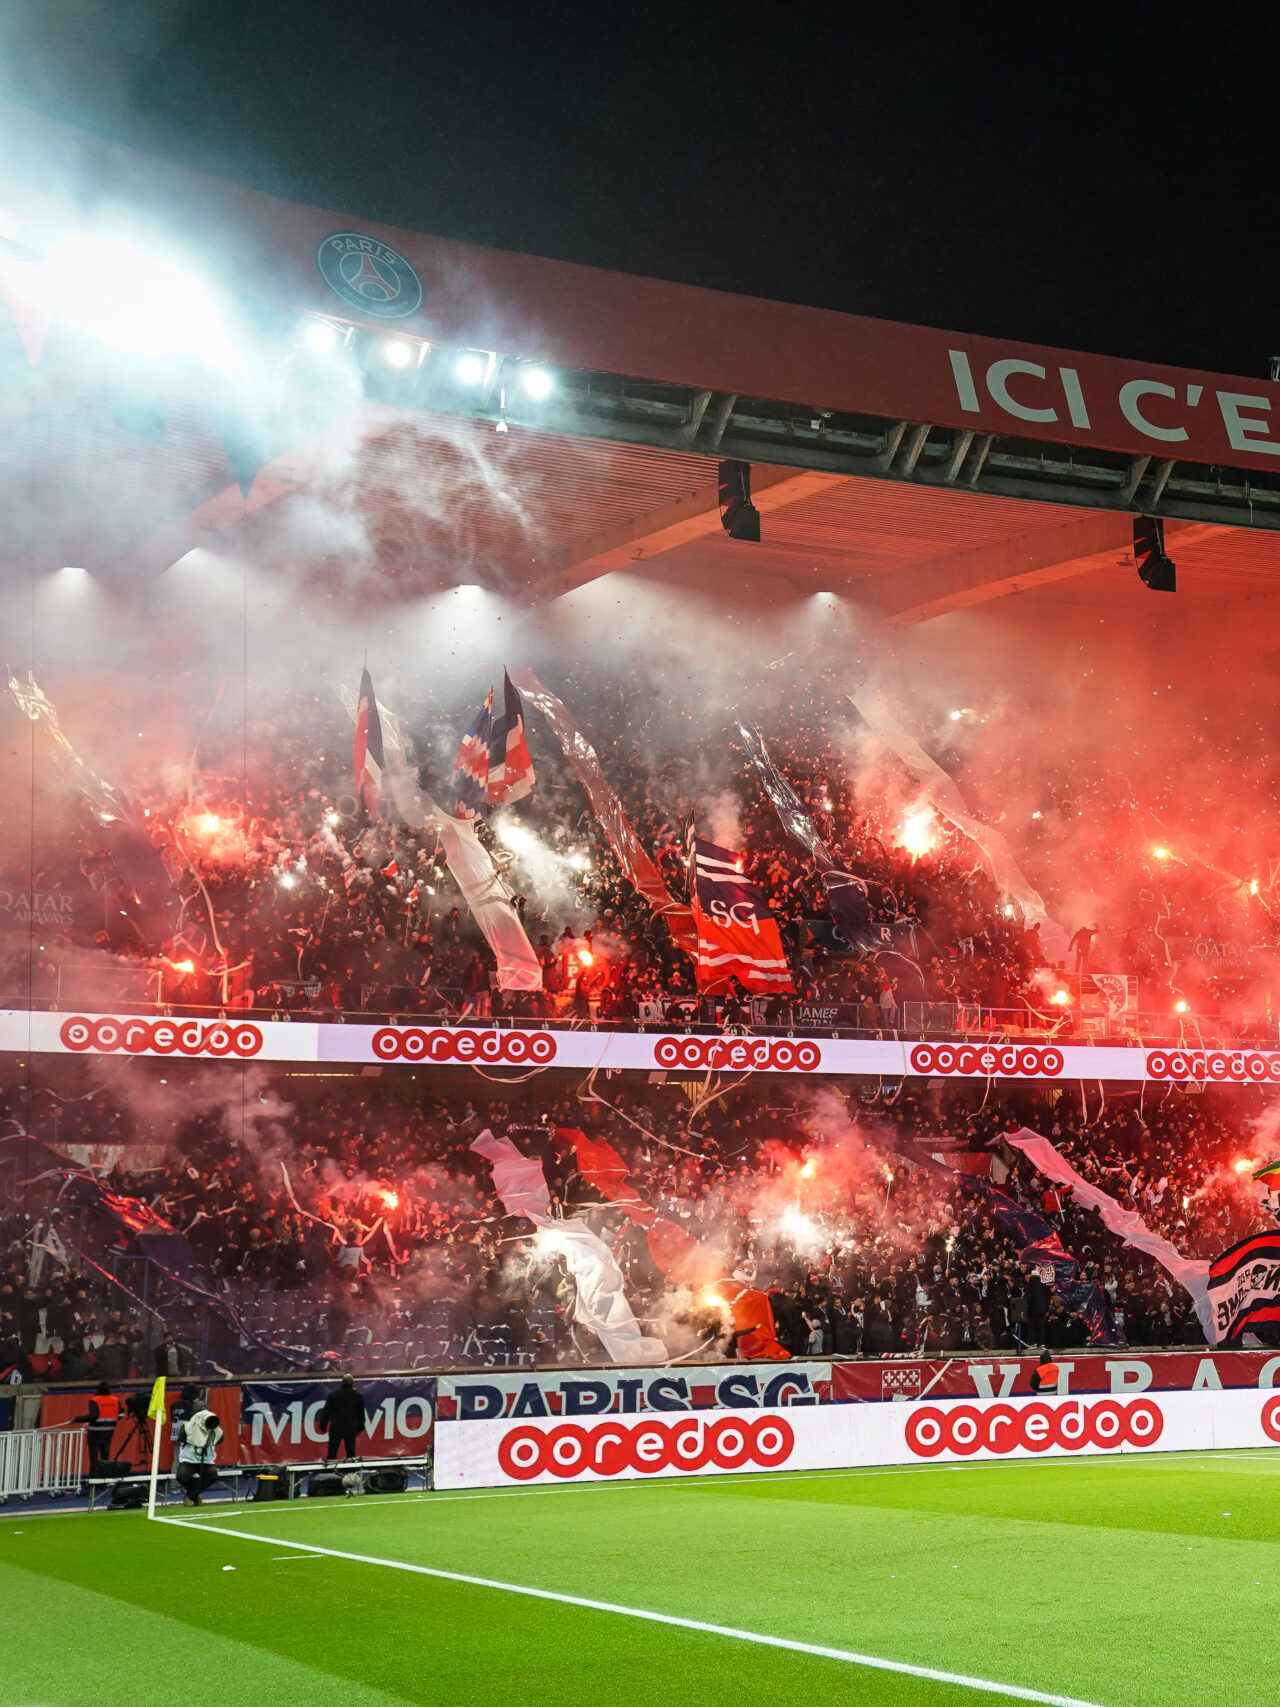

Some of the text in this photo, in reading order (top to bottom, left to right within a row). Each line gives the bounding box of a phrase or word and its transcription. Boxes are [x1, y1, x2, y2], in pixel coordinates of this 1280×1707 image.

[331, 238, 398, 265] PARIS
[947, 349, 1091, 430] ICI
[0, 890, 73, 912] QATAR
[13, 911, 74, 925] AIRWAYS
[66, 1018, 257, 1051] ooredoo
[378, 1028, 551, 1059] ooredoo
[660, 1037, 815, 1067] ooredoo
[915, 1045, 1060, 1073] ooredoo
[455, 1372, 819, 1421] PARIS SG
[913, 1400, 1155, 1449] ooredoo
[508, 1417, 785, 1471] ooredoo
